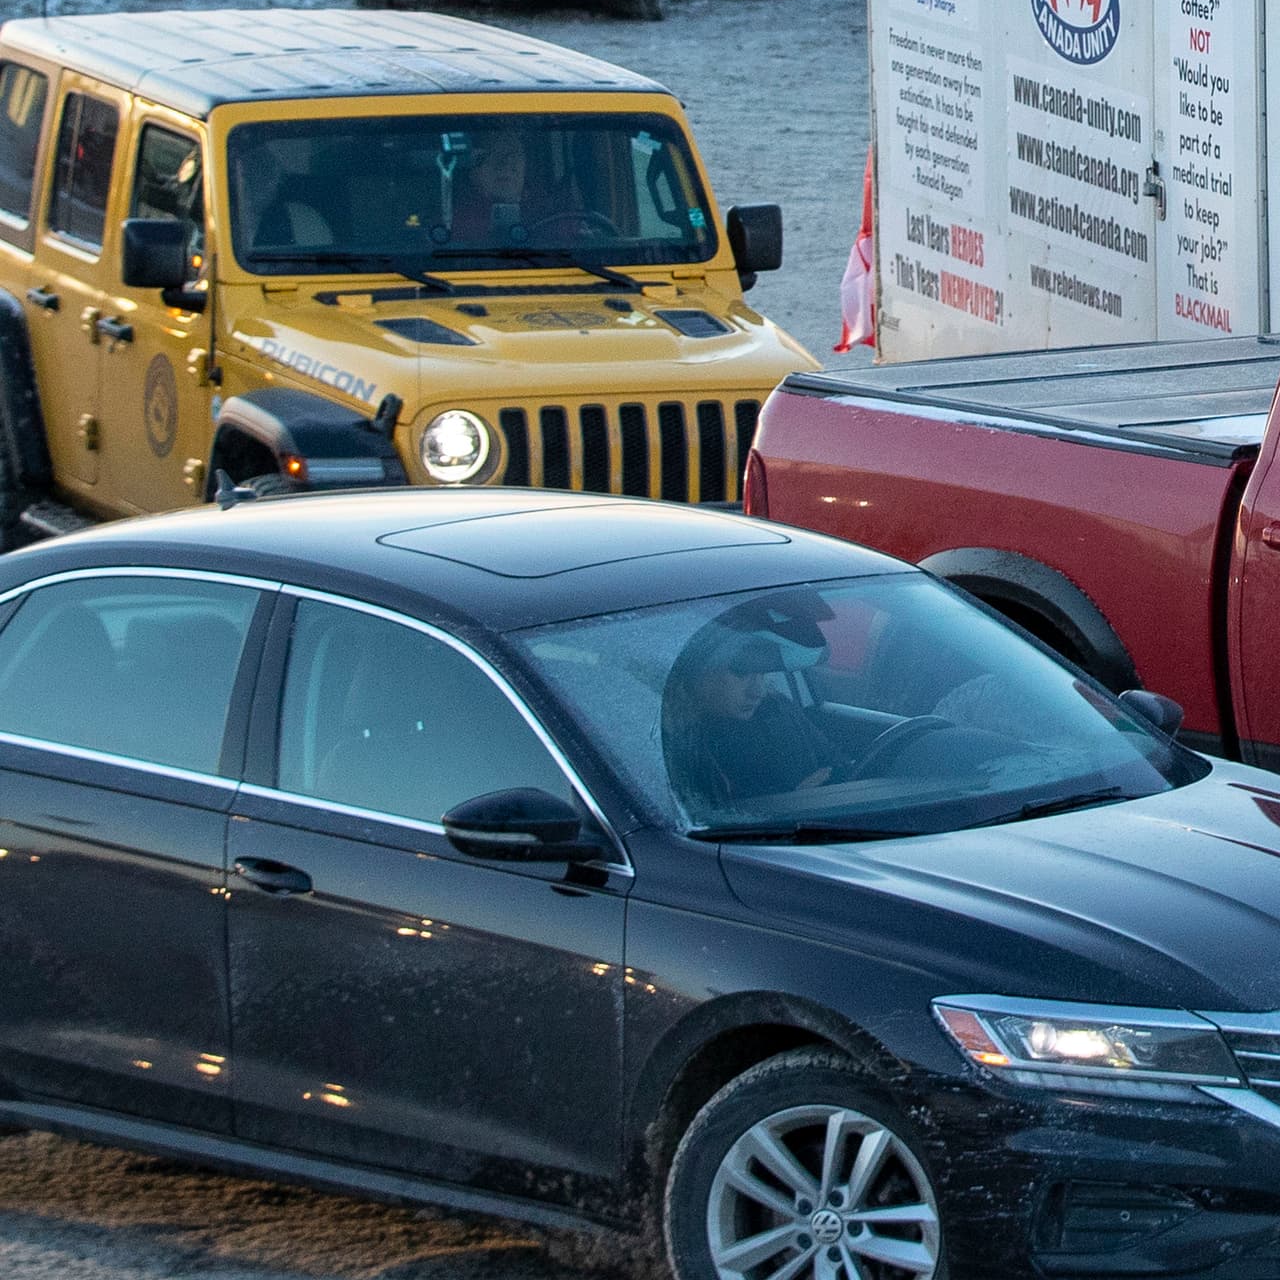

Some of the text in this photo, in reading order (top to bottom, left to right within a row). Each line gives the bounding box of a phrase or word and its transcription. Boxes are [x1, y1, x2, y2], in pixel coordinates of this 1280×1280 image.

[889, 27, 919, 52] Freedom
[926, 44, 946, 61] never
[946, 50, 966, 67] more
[1082, 9, 1116, 59] UNITY
[1189, 27, 1211, 55] NOT
[905, 63, 942, 86] generation
[1210, 74, 1230, 97] you
[1013, 74, 1142, 144] www.canada-unity.com
[1179, 91, 1223, 127] like to be
[944, 124, 979, 151] defended
[1179, 133, 1200, 155] part
[1201, 134, 1213, 160] of
[1213, 143, 1221, 160] a
[1016, 131, 1140, 205] www.standcanada.org
[1172, 162, 1232, 198] medical trial
[1009, 185, 1148, 263] www.action4canada.com
[1184, 198, 1220, 233] to keep
[906, 207, 985, 269] Last Years HEROES
[1176, 233, 1199, 256] your
[895, 252, 915, 292] This
[916, 260, 940, 302] Years
[1030, 263, 1123, 318] www.rebelnews.com
[1186, 263, 1219, 296] That is
[1175, 292, 1233, 334] BLACKMAIL
[262, 338, 377, 402] RUBICON
